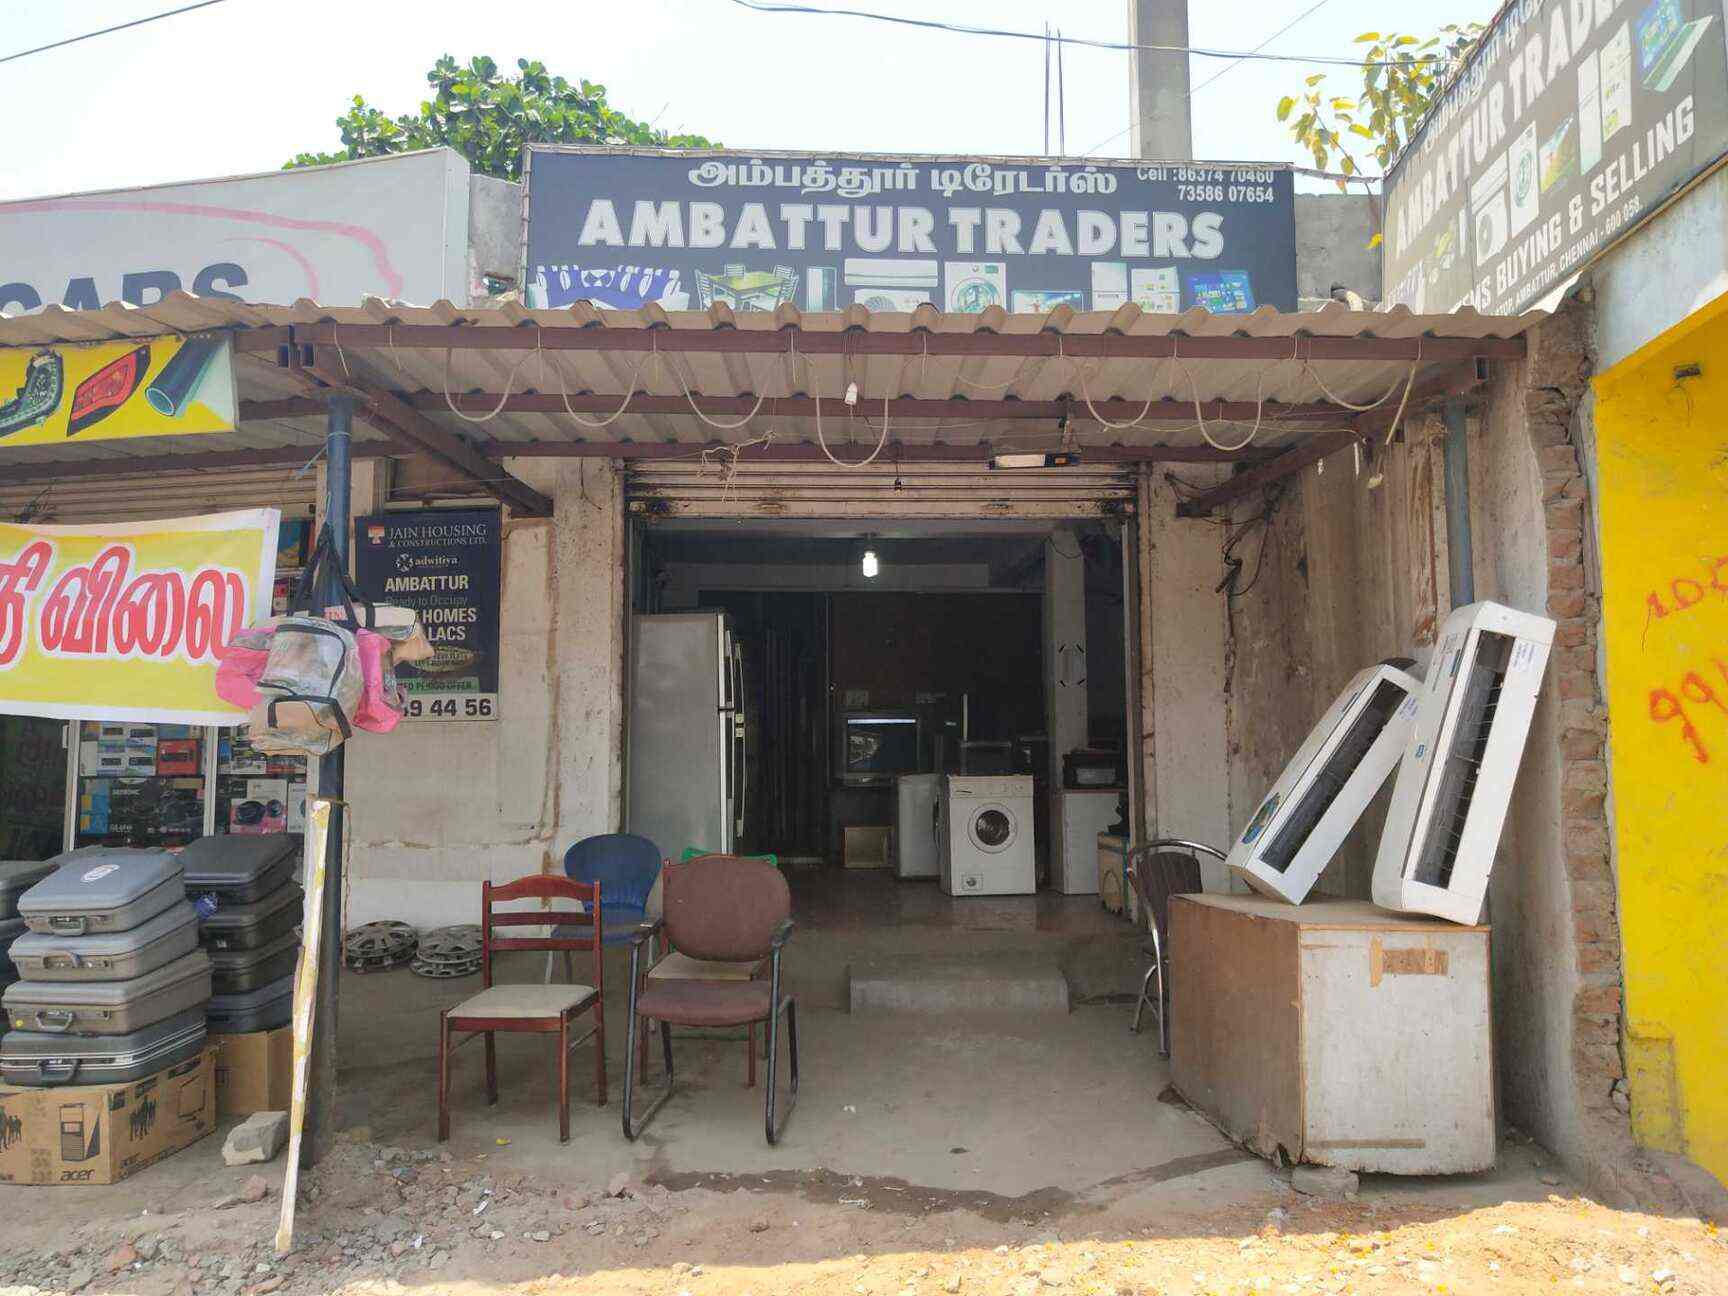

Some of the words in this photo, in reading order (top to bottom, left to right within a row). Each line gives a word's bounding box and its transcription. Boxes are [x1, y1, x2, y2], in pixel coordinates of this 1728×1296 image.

[688, 159, 919, 198] அம்பத்தூர்
[931, 163, 1118, 197] டிரேடர்ஸ்
[1137, 167, 1167, 181] Cell
[1395, 80, 1506, 260] AMBATTUR
[1178, 185, 1223, 201] 73586
[1228, 186, 1274, 203] 07654
[1496, 211, 1562, 297] BUYING
[1568, 194, 1583, 235] &
[1590, 94, 1695, 217] SELLING
[578, 199, 937, 253] AMBATTUR
[947, 207, 1224, 260] TRADERS
[1559, 227, 1600, 272] CHENNAI
[387, 527, 418, 540] JAIN
[422, 524, 487, 539] HOUSING
[384, 575, 469, 592] AMBATTUR
[422, 607, 477, 624] HOMES
[428, 625, 466, 641] LACS
[430, 698, 457, 717] 44
[464, 697, 492, 717] 56
[60, 1168, 95, 1181] acer
